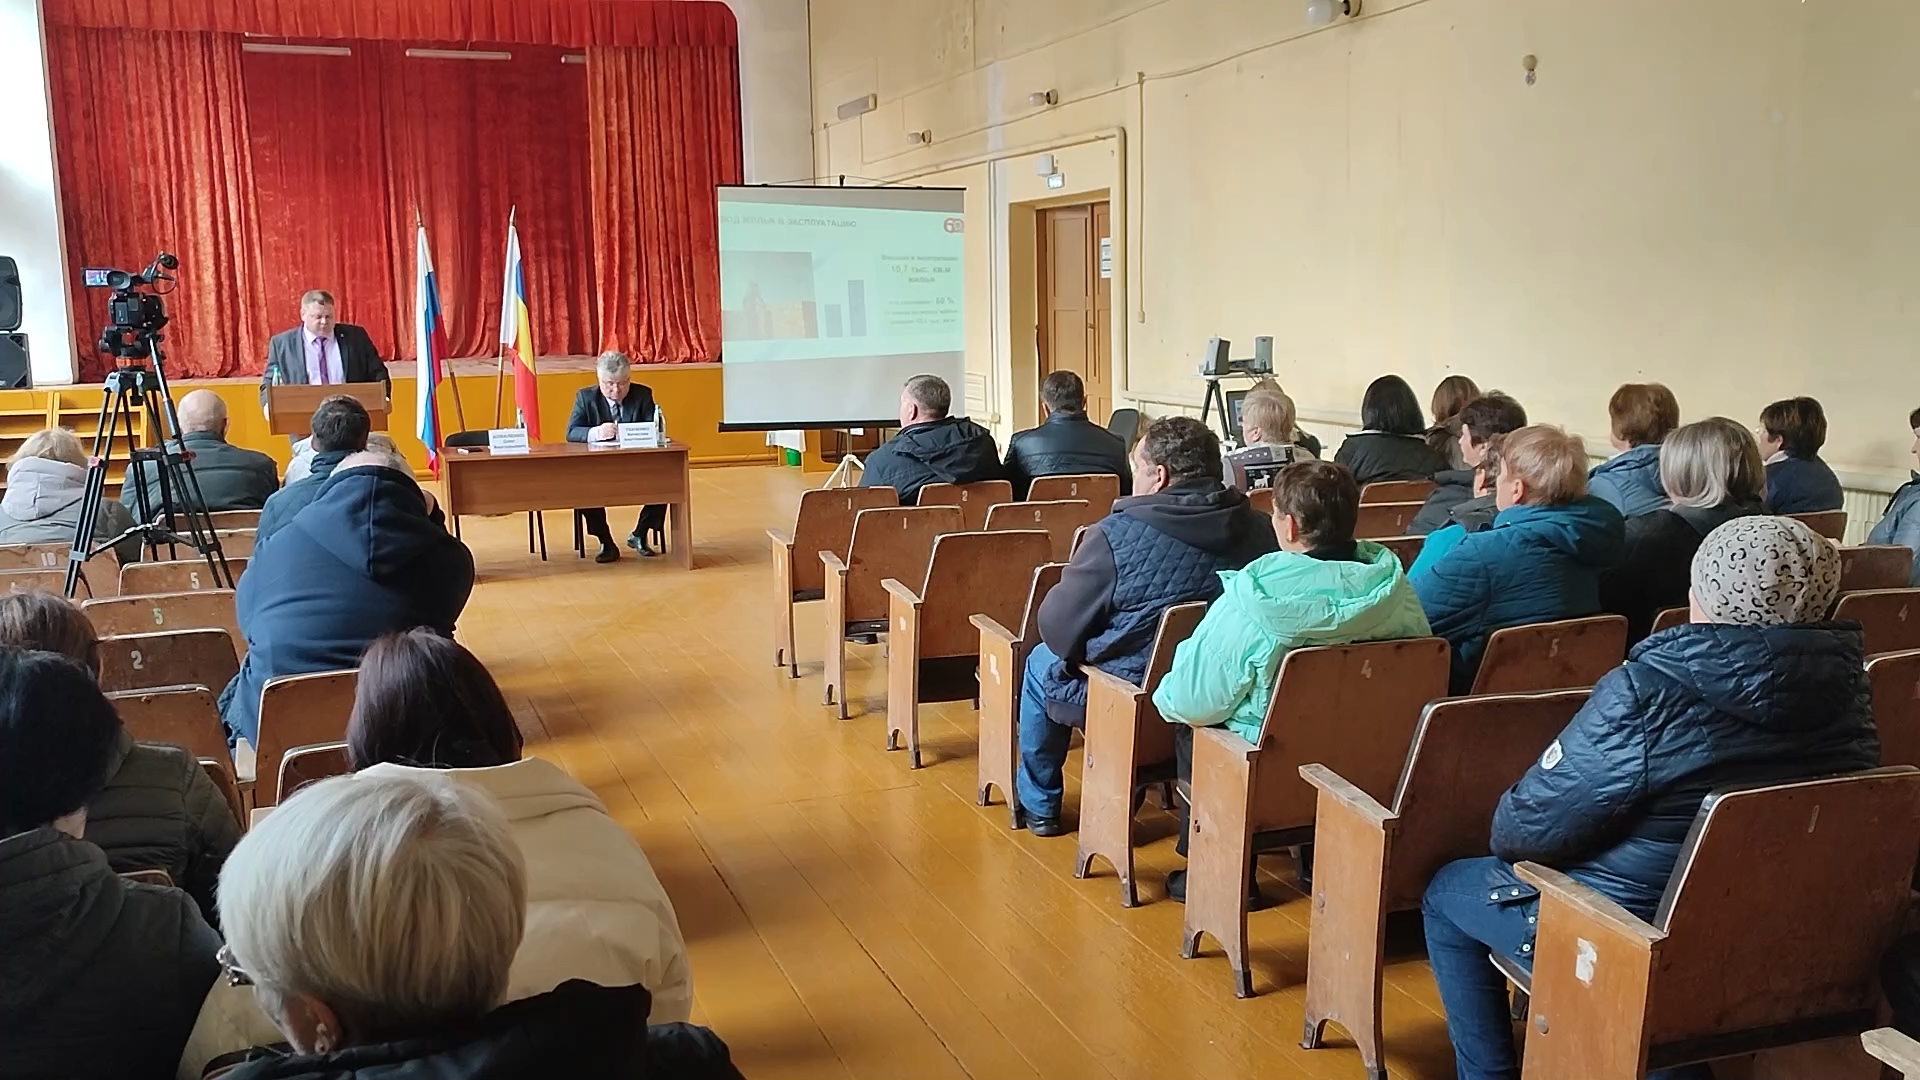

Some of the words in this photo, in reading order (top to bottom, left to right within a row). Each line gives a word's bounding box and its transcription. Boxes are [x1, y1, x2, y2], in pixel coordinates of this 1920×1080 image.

[961, 490, 969, 502] 2
[1070, 482, 1078, 496] 3
[1033, 509, 1042, 523] 2
[40, 551, 57, 567] 10
[189, 572, 200, 590] 5
[152, 606, 165, 625] 5
[1550, 637, 1561, 657] 5
[130, 650, 144, 670] 2
[1360, 659, 1372, 679] 4
